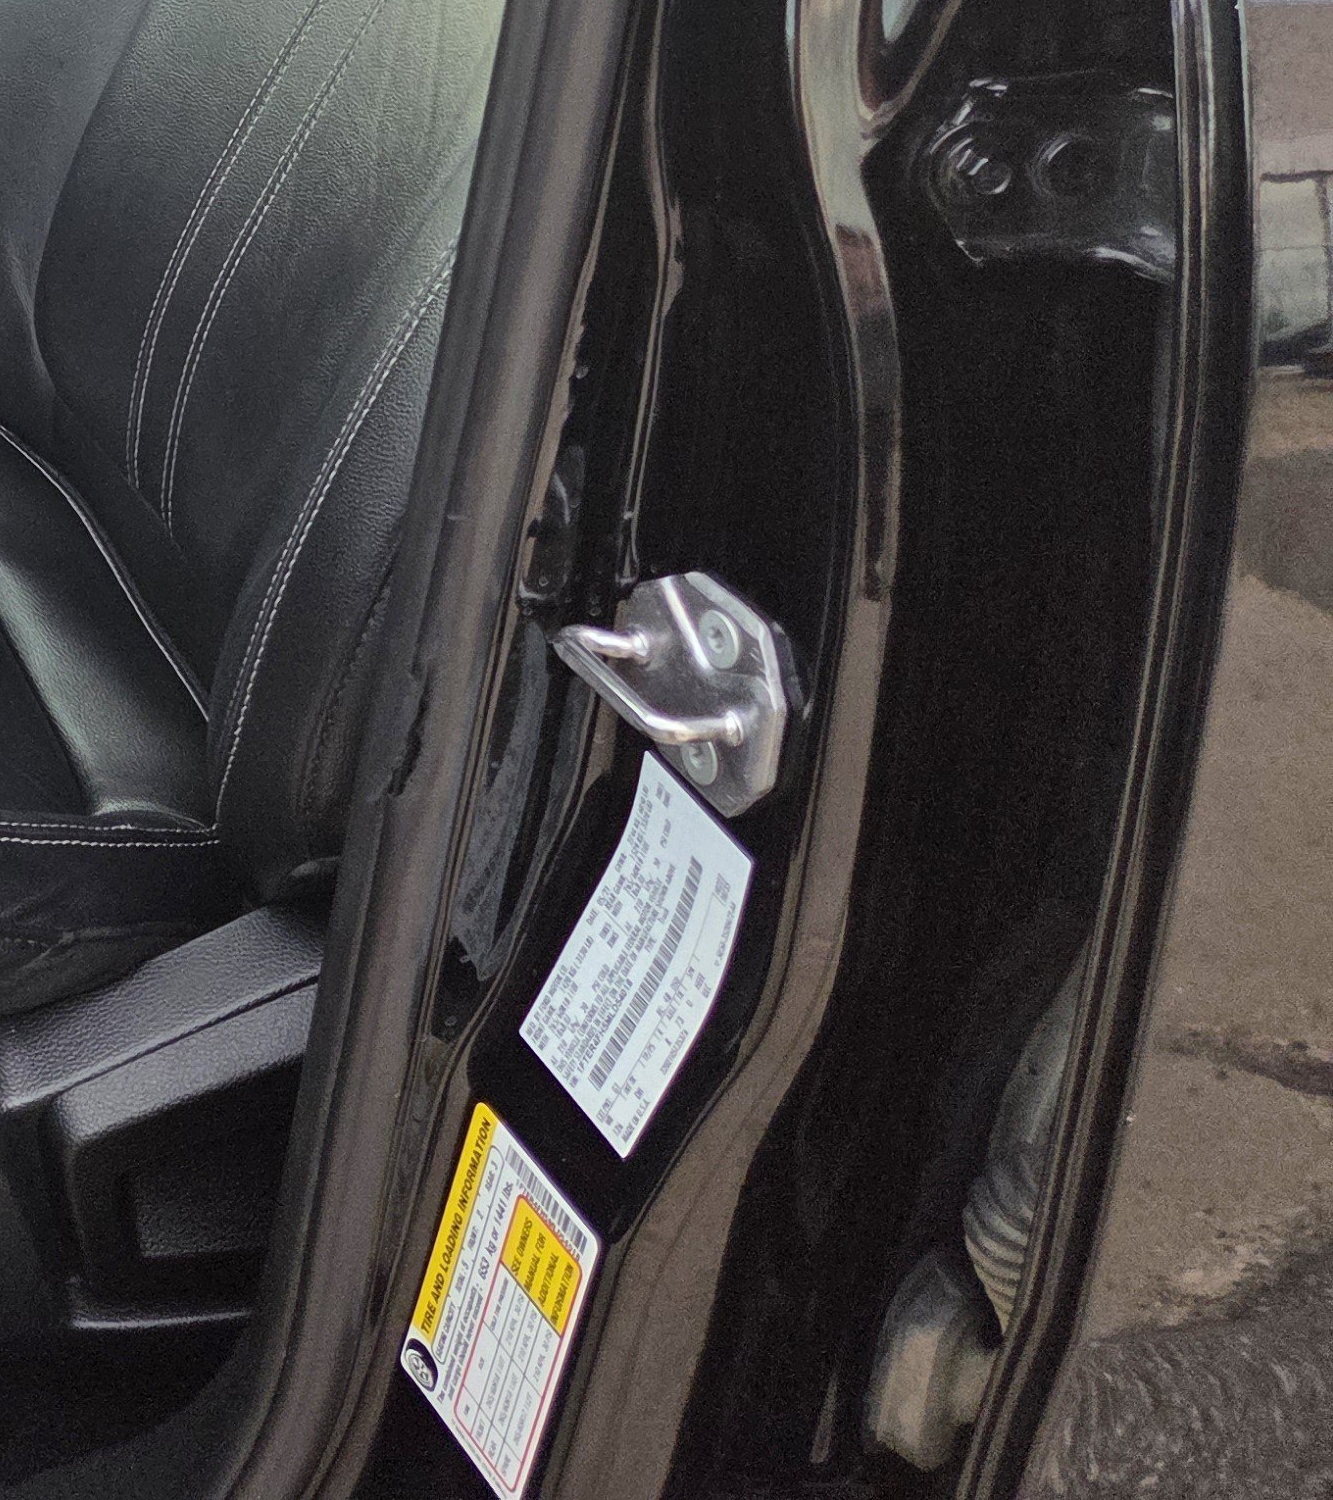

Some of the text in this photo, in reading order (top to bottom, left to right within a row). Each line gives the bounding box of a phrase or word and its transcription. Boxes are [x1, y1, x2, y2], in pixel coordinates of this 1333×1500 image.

[421, 1119, 491, 1335] TIRE AND LOADING INFORMATION
[491, 1225, 499, 1242] or
[494, 1198, 507, 1227] 1441
[485, 1237, 496, 1259] kg
[525, 1231, 546, 1293] MANUAL FOR
[539, 1251, 559, 1307] ADDITIONAL
[551, 1263, 574, 1325] INFORMATION
